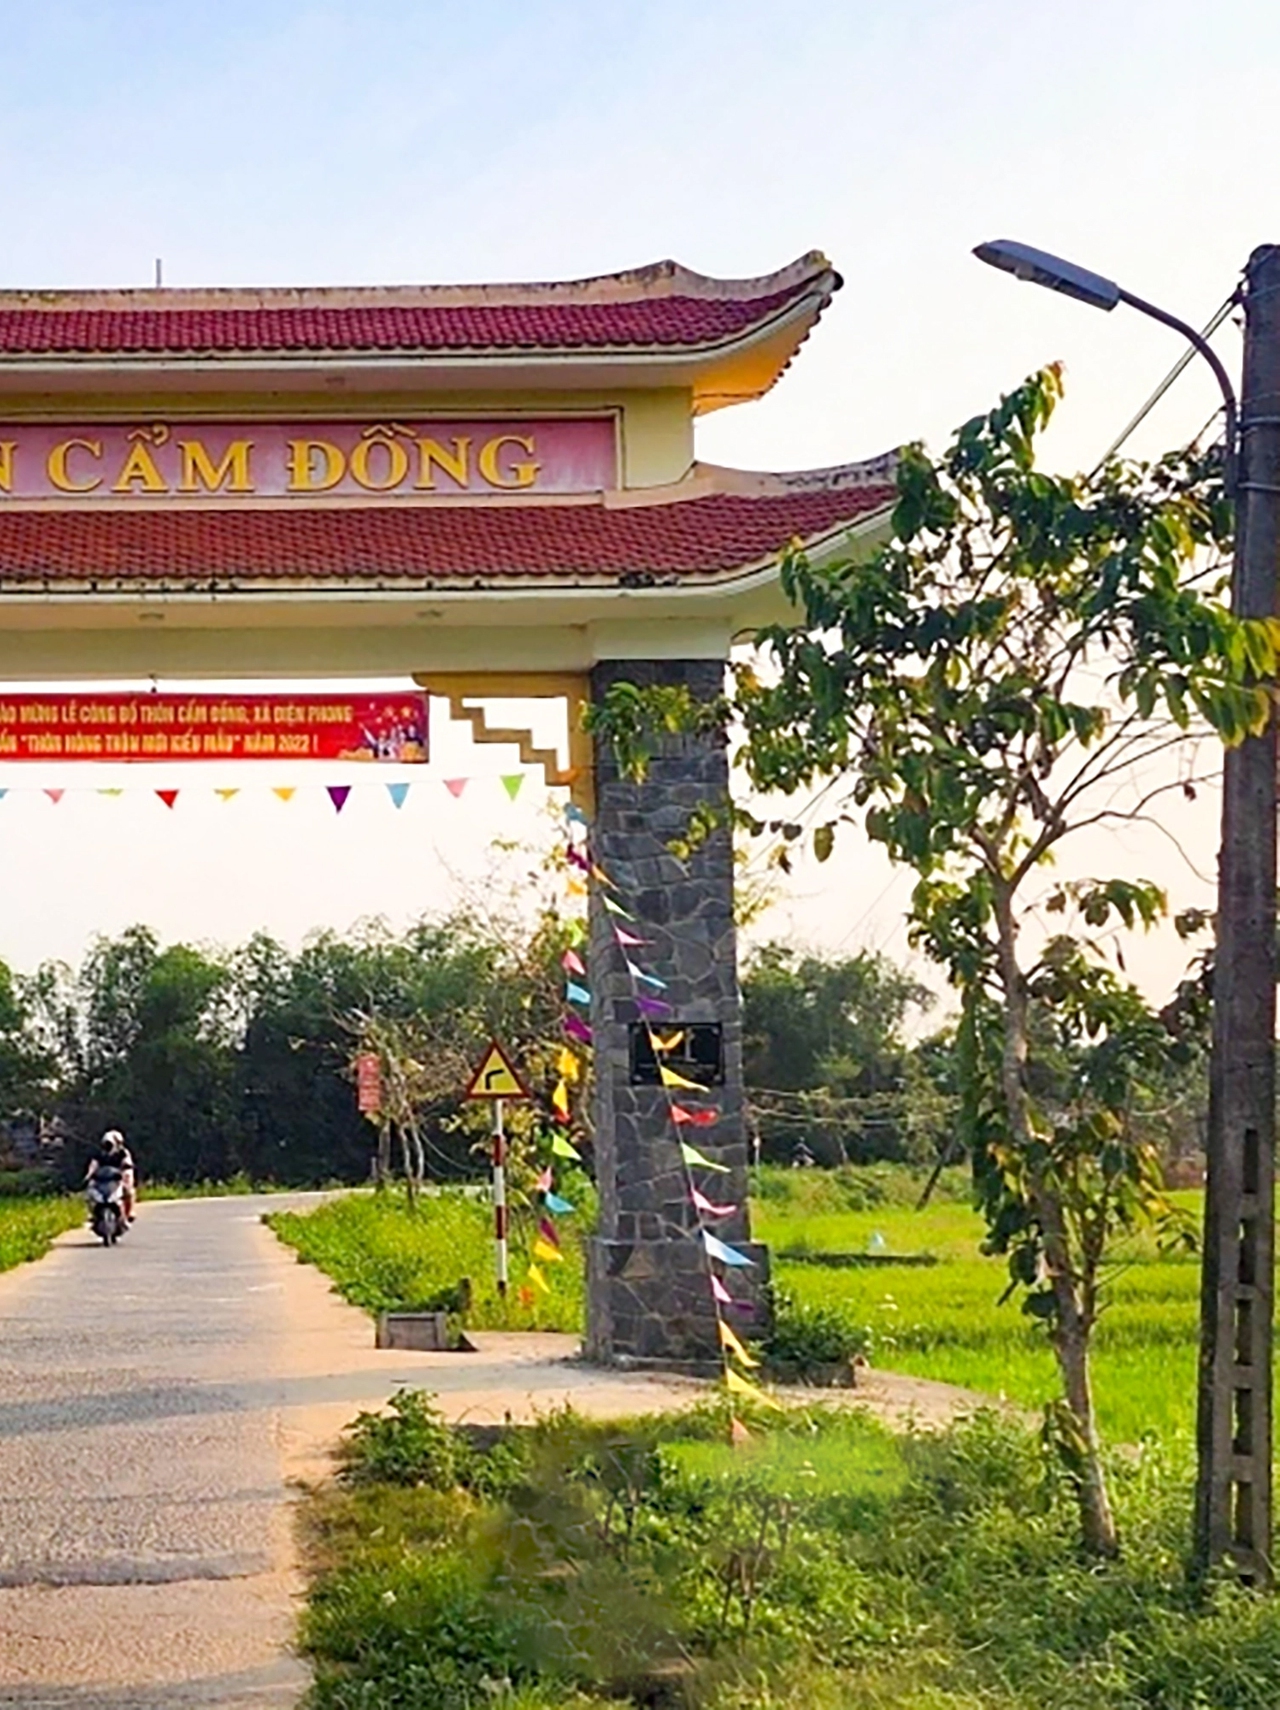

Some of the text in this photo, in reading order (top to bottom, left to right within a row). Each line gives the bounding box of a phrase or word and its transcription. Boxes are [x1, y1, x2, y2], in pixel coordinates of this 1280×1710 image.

[47, 423, 255, 494] CẨM
[287, 422, 542, 493] ĐỒNG
[278, 733, 310, 753] 2022
